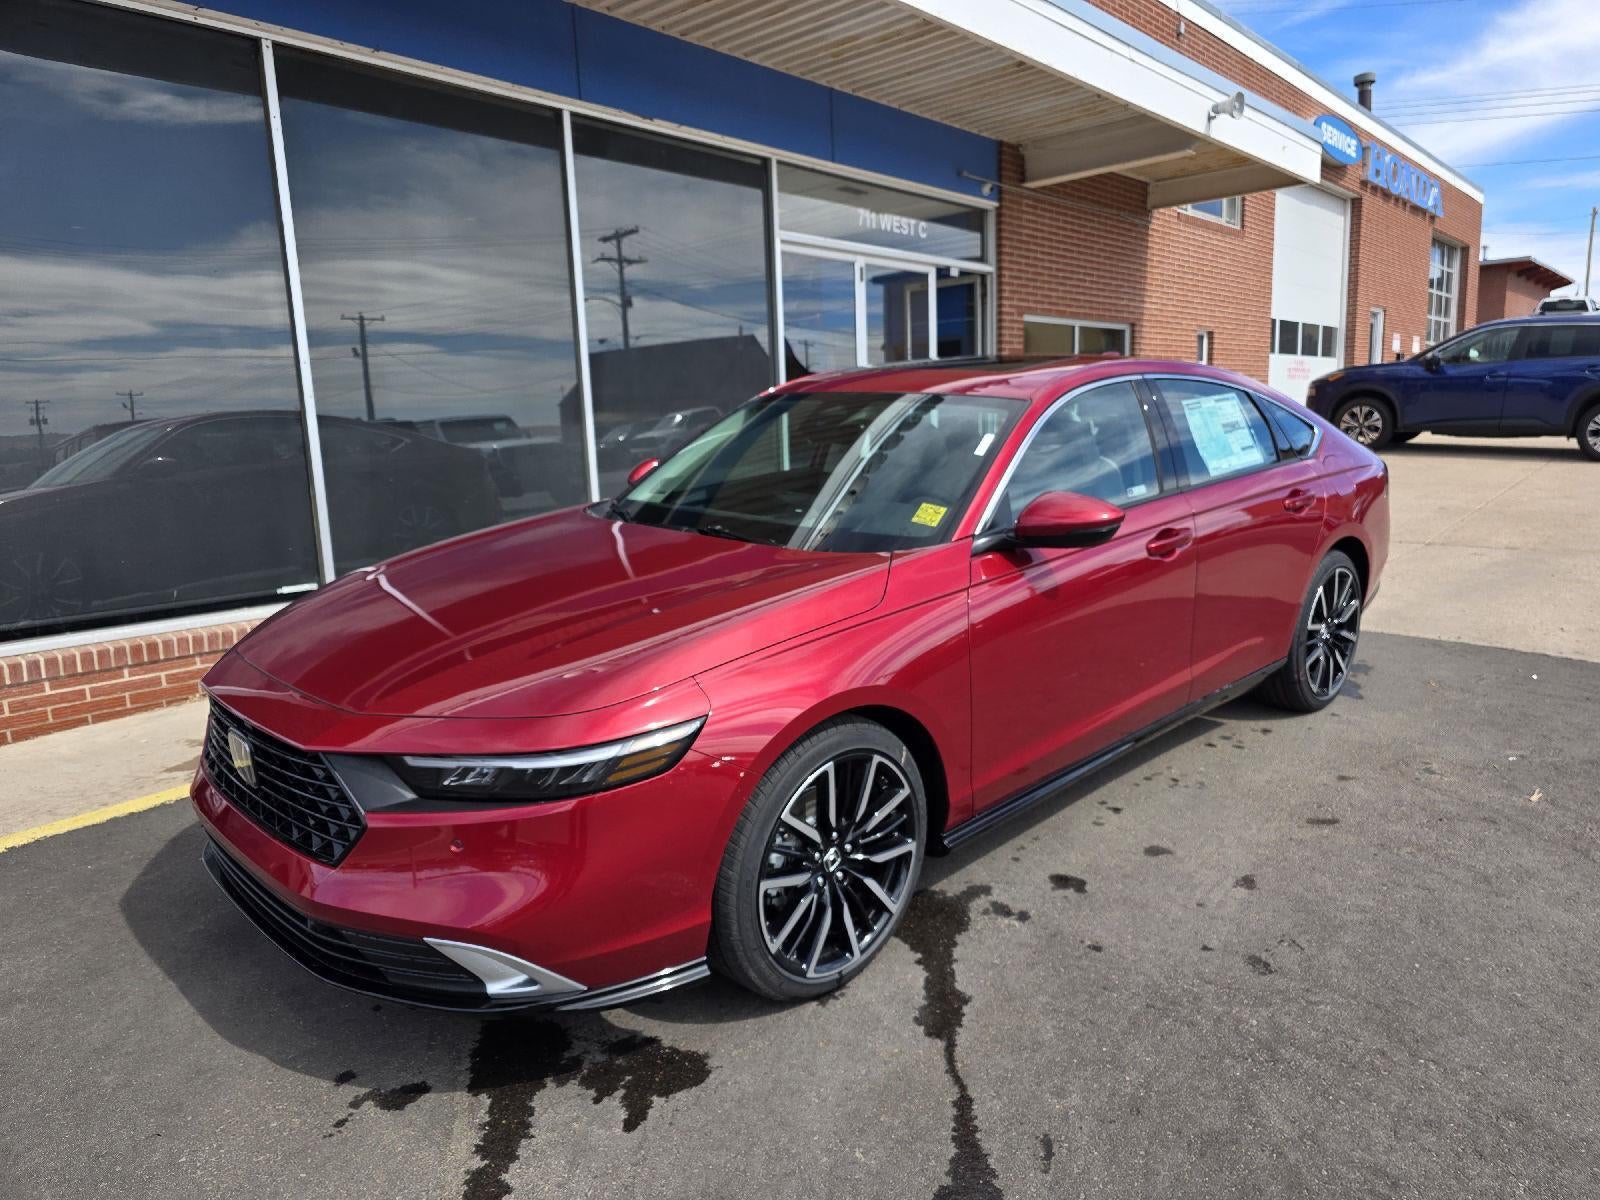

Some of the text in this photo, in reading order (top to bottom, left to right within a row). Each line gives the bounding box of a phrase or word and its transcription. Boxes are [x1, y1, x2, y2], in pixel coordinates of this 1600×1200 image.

[1321, 122, 1358, 159] SERVICE
[1368, 140, 1444, 217] HONDA
[858, 207, 928, 238] 711 WEST C
